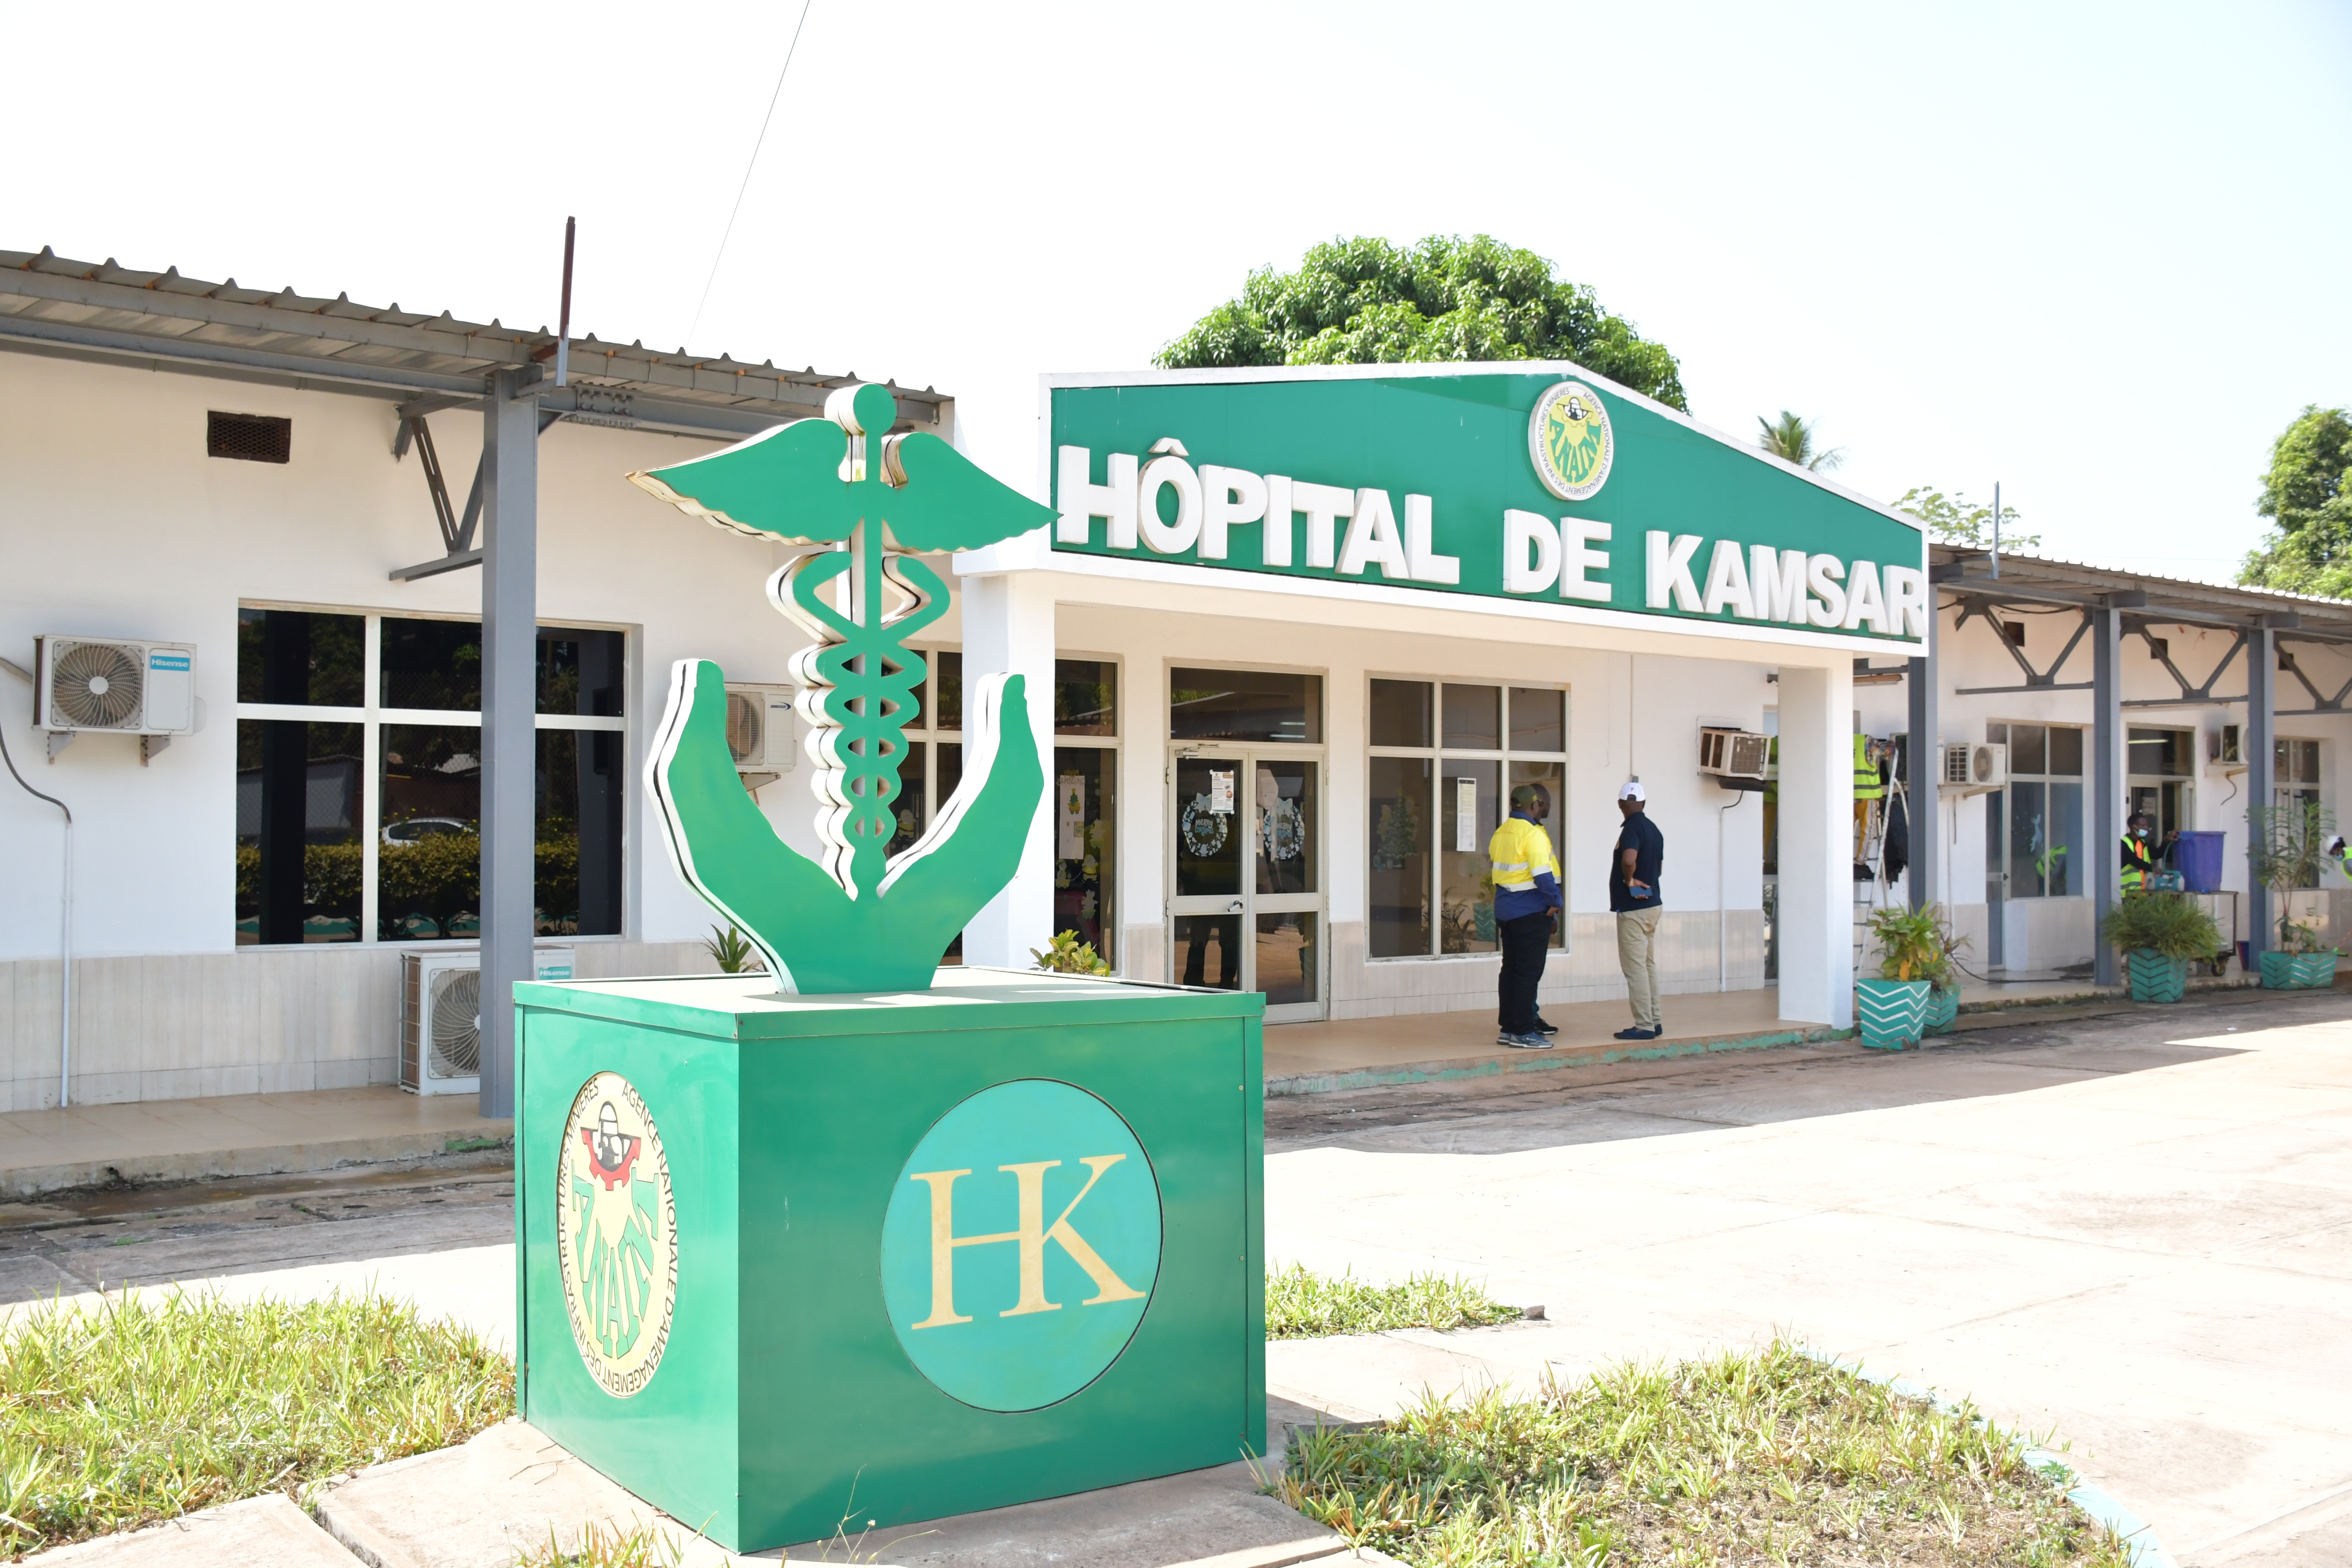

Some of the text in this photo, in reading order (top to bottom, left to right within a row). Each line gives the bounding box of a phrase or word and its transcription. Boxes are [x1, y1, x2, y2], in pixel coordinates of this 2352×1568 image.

[1583, 392, 1603, 416] AGENCE
[1539, 407, 1555, 479] INFRASTRUCTURES
[1600, 416, 1610, 463] NATIONALE
[1554, 477, 1565, 489] DES
[1057, 437, 1928, 637] HÔPITAL DE KAMSAR
[152, 659, 188, 667] Hisense
[559, 1078, 678, 1393] AGENCE NATIONALE D'AMENAGEMENT DES INFRASTRUCTURES MINIERES
[910, 1154, 1146, 1329] HK
